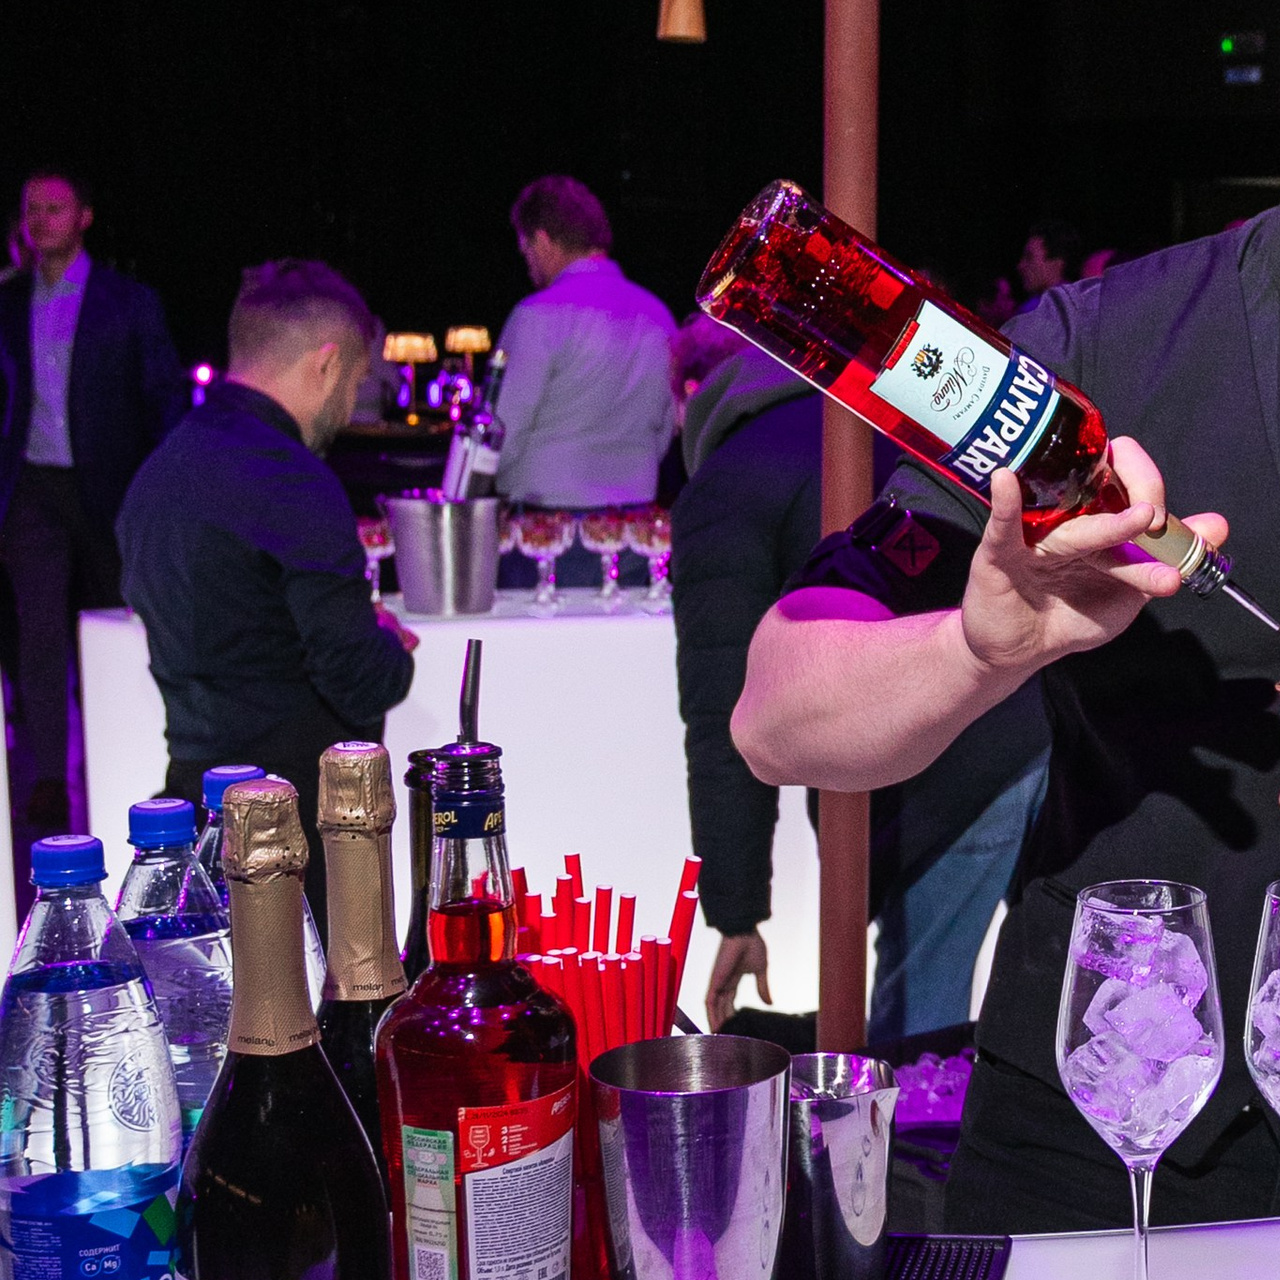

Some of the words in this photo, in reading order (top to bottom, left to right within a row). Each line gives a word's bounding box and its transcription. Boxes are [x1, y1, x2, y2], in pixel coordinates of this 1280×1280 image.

[953, 355, 1048, 482] CAMPARI
[79, 1244, 121, 1257] СОДЕРЖИТ
[85, 1263, 97, 1271] Ca
[104, 1260, 118, 1270] Mg
